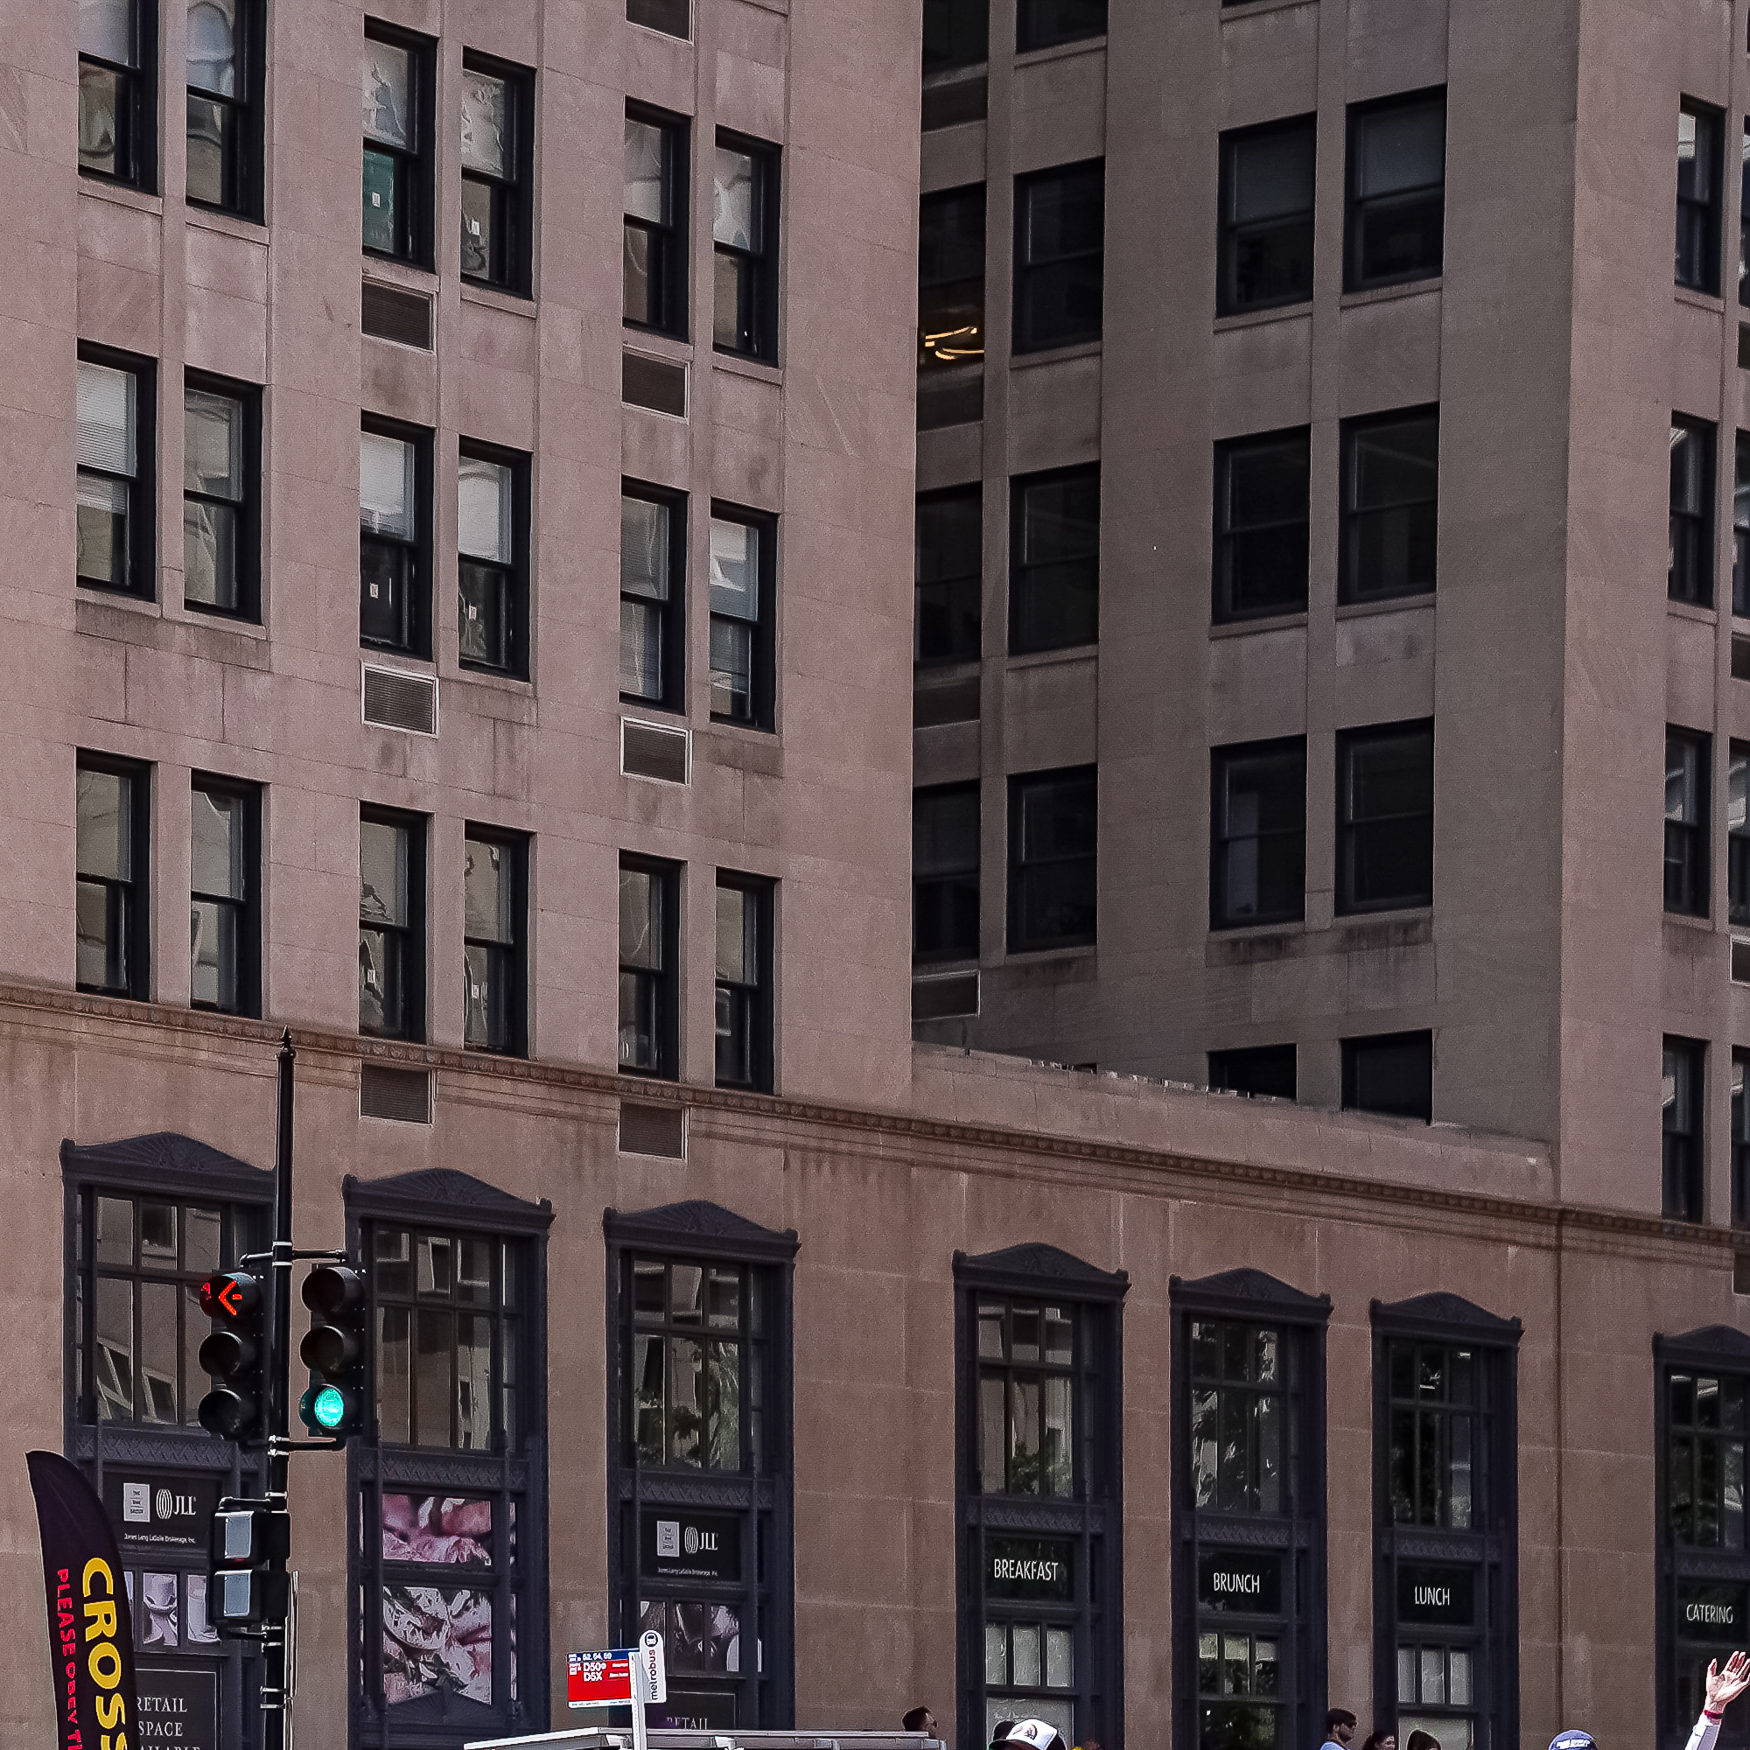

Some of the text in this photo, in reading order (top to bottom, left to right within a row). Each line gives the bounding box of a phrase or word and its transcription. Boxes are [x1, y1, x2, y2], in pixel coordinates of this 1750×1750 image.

[173, 1495, 197, 1516] JLL
[699, 1532, 718, 1550] JLL
[994, 1558, 1059, 1581] BREAKFAST
[1213, 1572, 1260, 1593] BRUNCH
[1414, 1585, 1450, 1606] LUNCH
[56, 1568, 77, 1657] PLEASE
[1686, 1603, 1734, 1624] CATERING
[648, 1649, 659, 1700] metrobus
[65, 1661, 78, 1724] OBEY
[138, 1720, 183, 1737] SPACE
